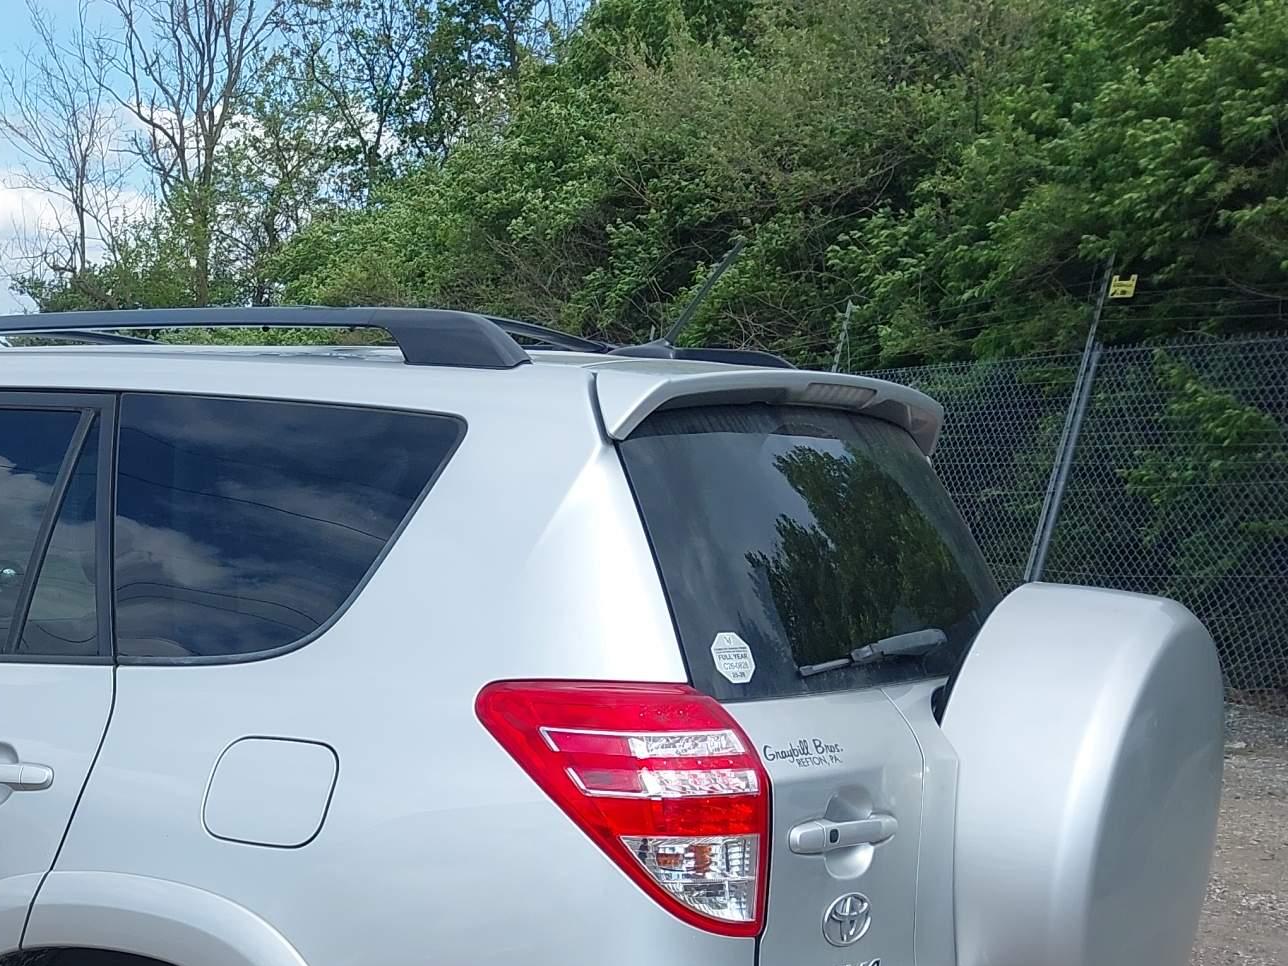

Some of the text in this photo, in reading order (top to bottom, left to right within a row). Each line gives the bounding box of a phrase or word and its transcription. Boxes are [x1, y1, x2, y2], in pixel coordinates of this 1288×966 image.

[733, 652, 748, 660] YEAR
[763, 738, 844, 763] Graybill Bros.
